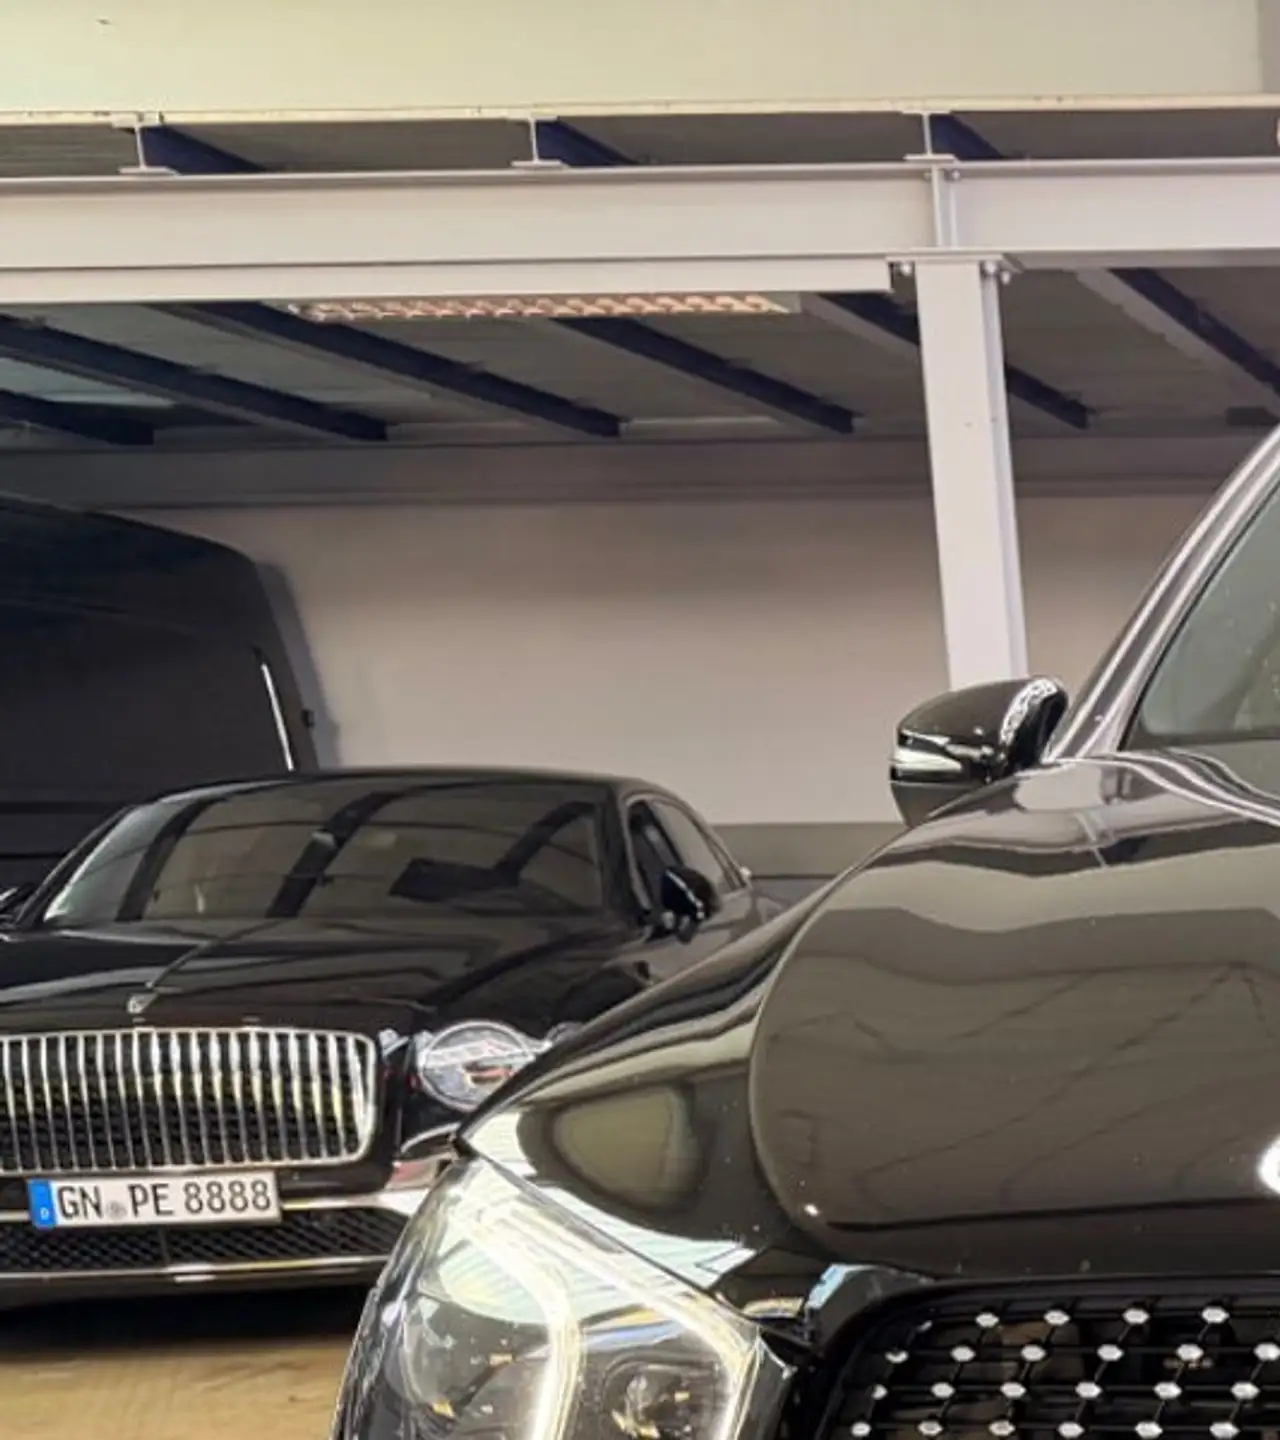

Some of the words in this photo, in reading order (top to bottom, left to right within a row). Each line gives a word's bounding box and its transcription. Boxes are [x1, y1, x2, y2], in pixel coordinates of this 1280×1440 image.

[57, 1185, 104, 1220] GN
[128, 1182, 174, 1218] PE
[182, 1179, 271, 1215] 8888
